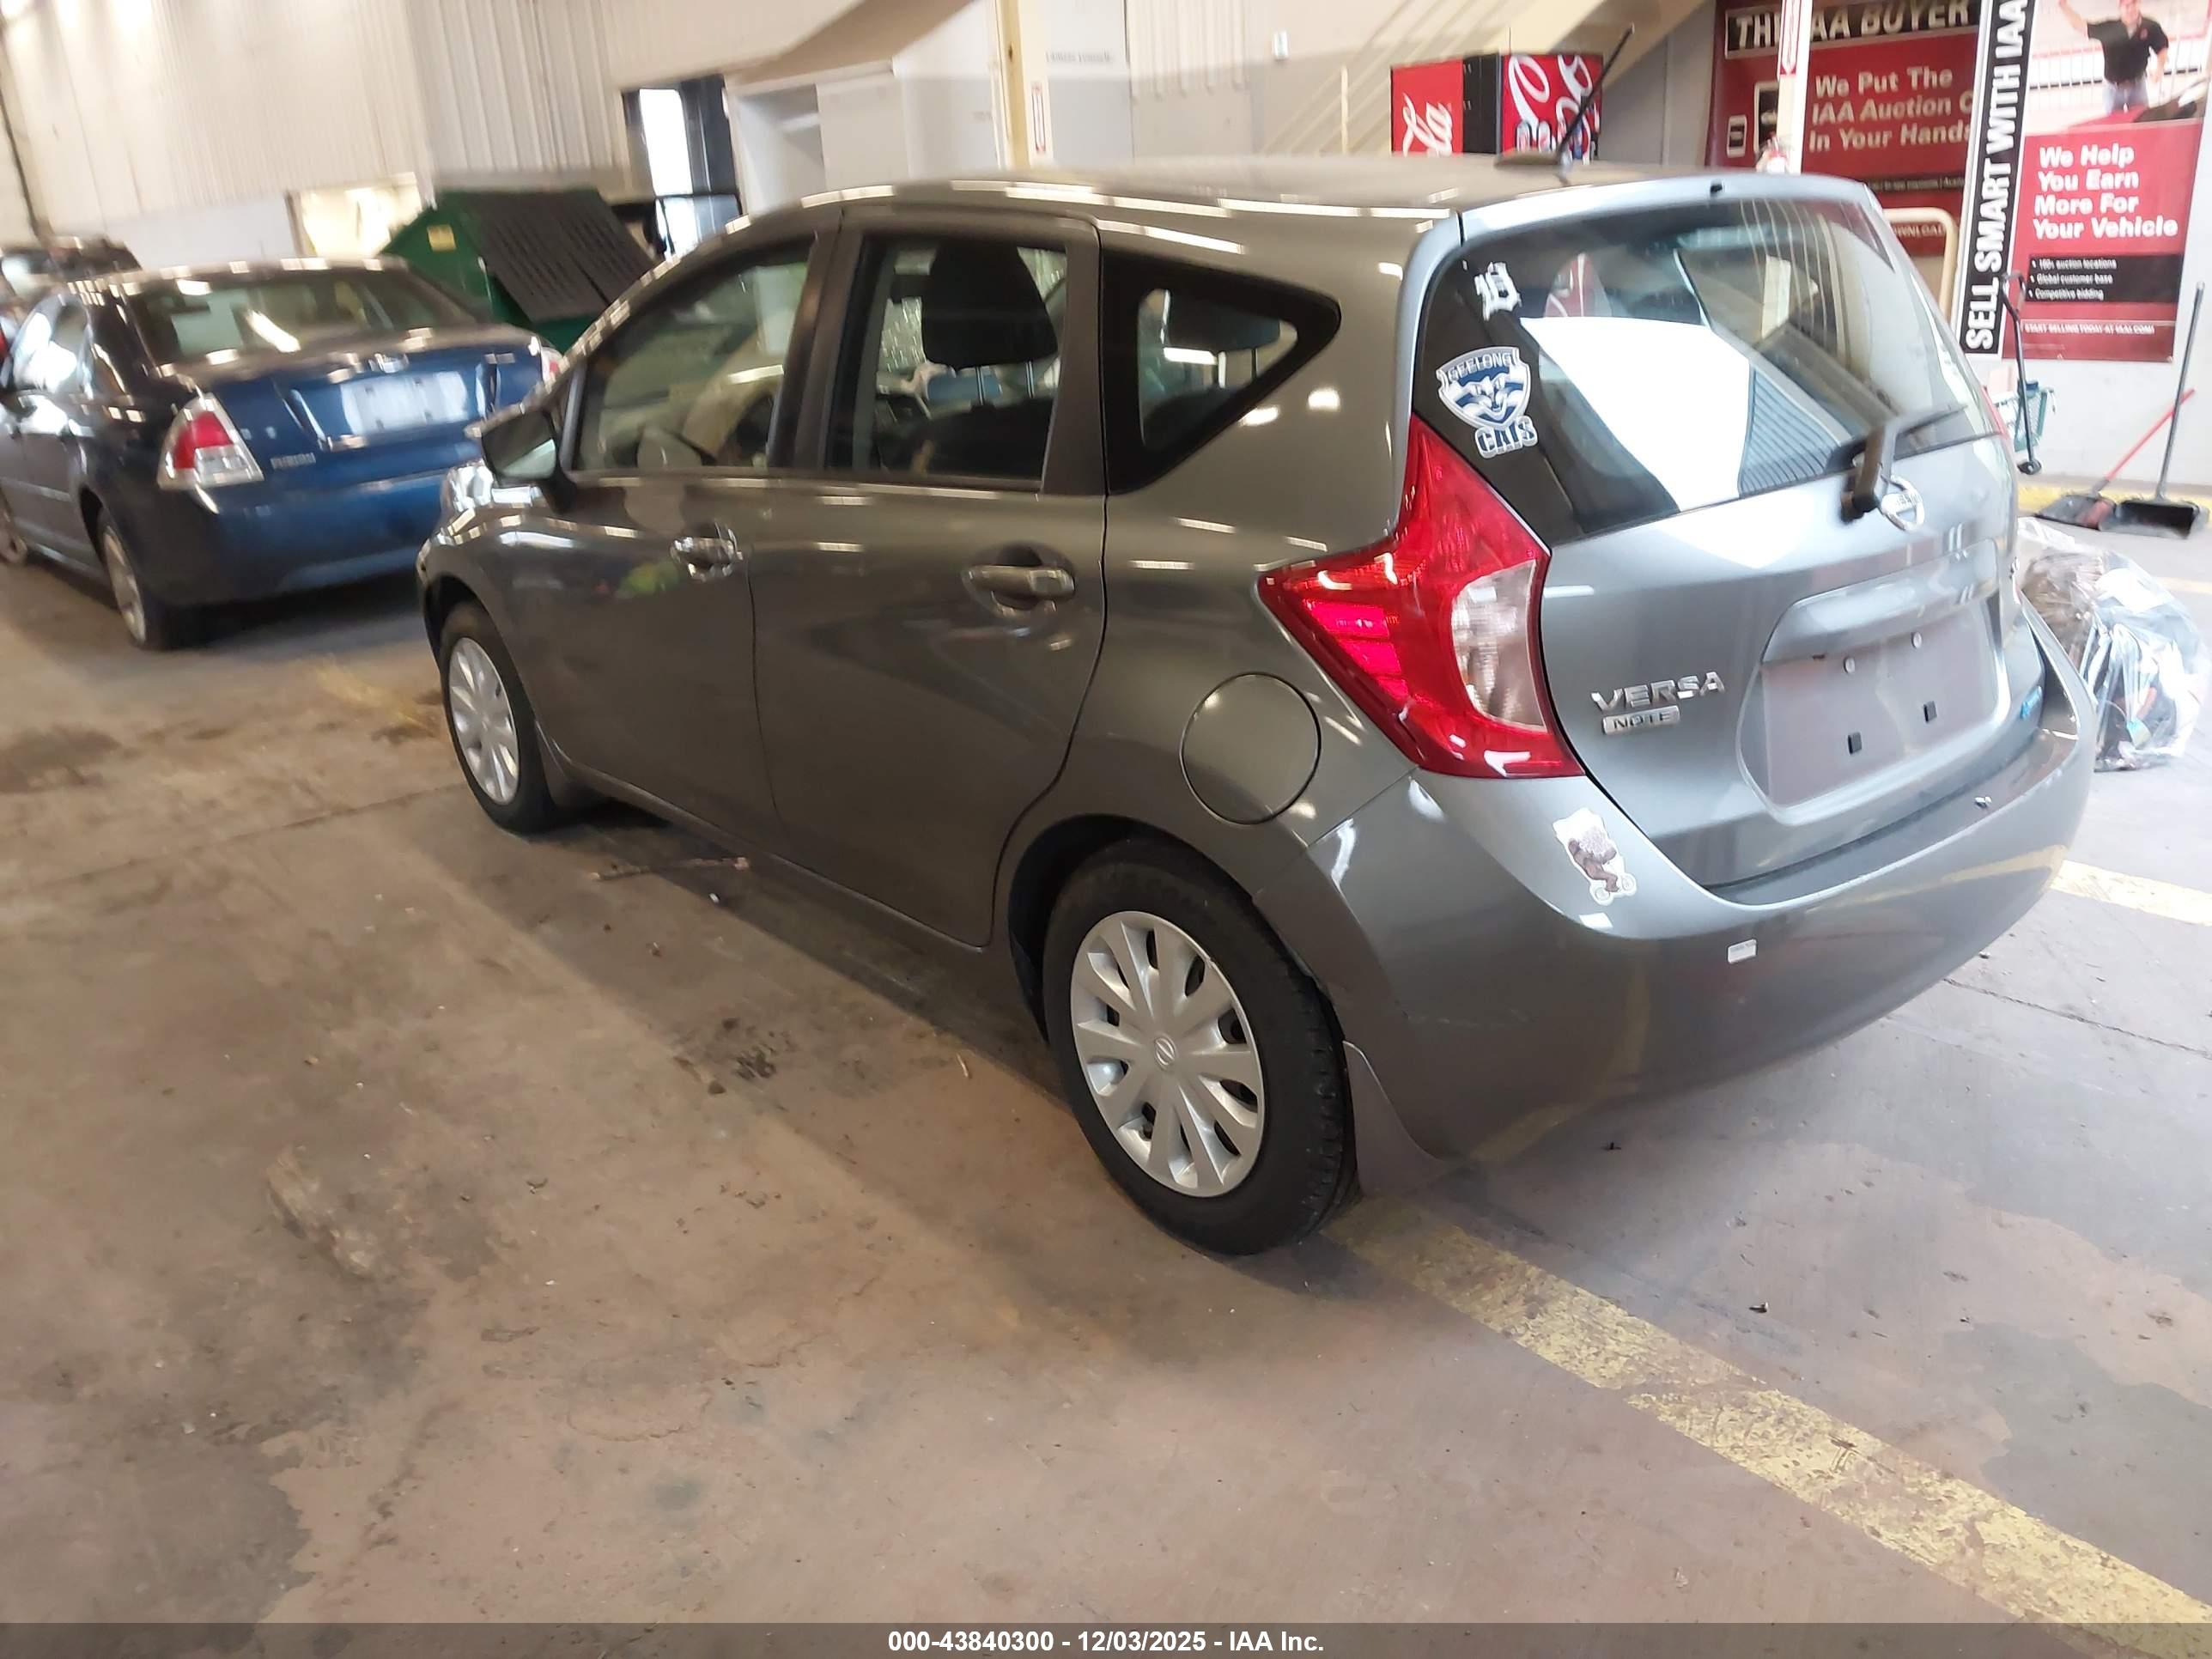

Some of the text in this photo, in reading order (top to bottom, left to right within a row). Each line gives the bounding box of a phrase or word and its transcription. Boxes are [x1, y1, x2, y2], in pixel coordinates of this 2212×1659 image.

[1810, 7, 1850, 41] AA
[1860, 0, 1969, 35] BUYER
[1815, 65, 1953, 99] We Put The
[1812, 100, 1855, 125] IAA
[1860, 94, 1952, 123] Auction
[1809, 130, 1830, 152] In
[1838, 127, 1893, 150] Your
[2039, 143, 2135, 168] We Help
[1966, 0, 2027, 349] SELL SMART WITH IAA
[2038, 168, 2139, 192] You Earn
[2034, 192, 2140, 216] More For
[2033, 215, 2179, 240] Your Vehicle
[1448, 352, 1512, 382] GEELONG
[1476, 417, 1537, 454] CATS
[1591, 672, 1725, 711] VERSA
[1613, 712, 1671, 729] NOTE
